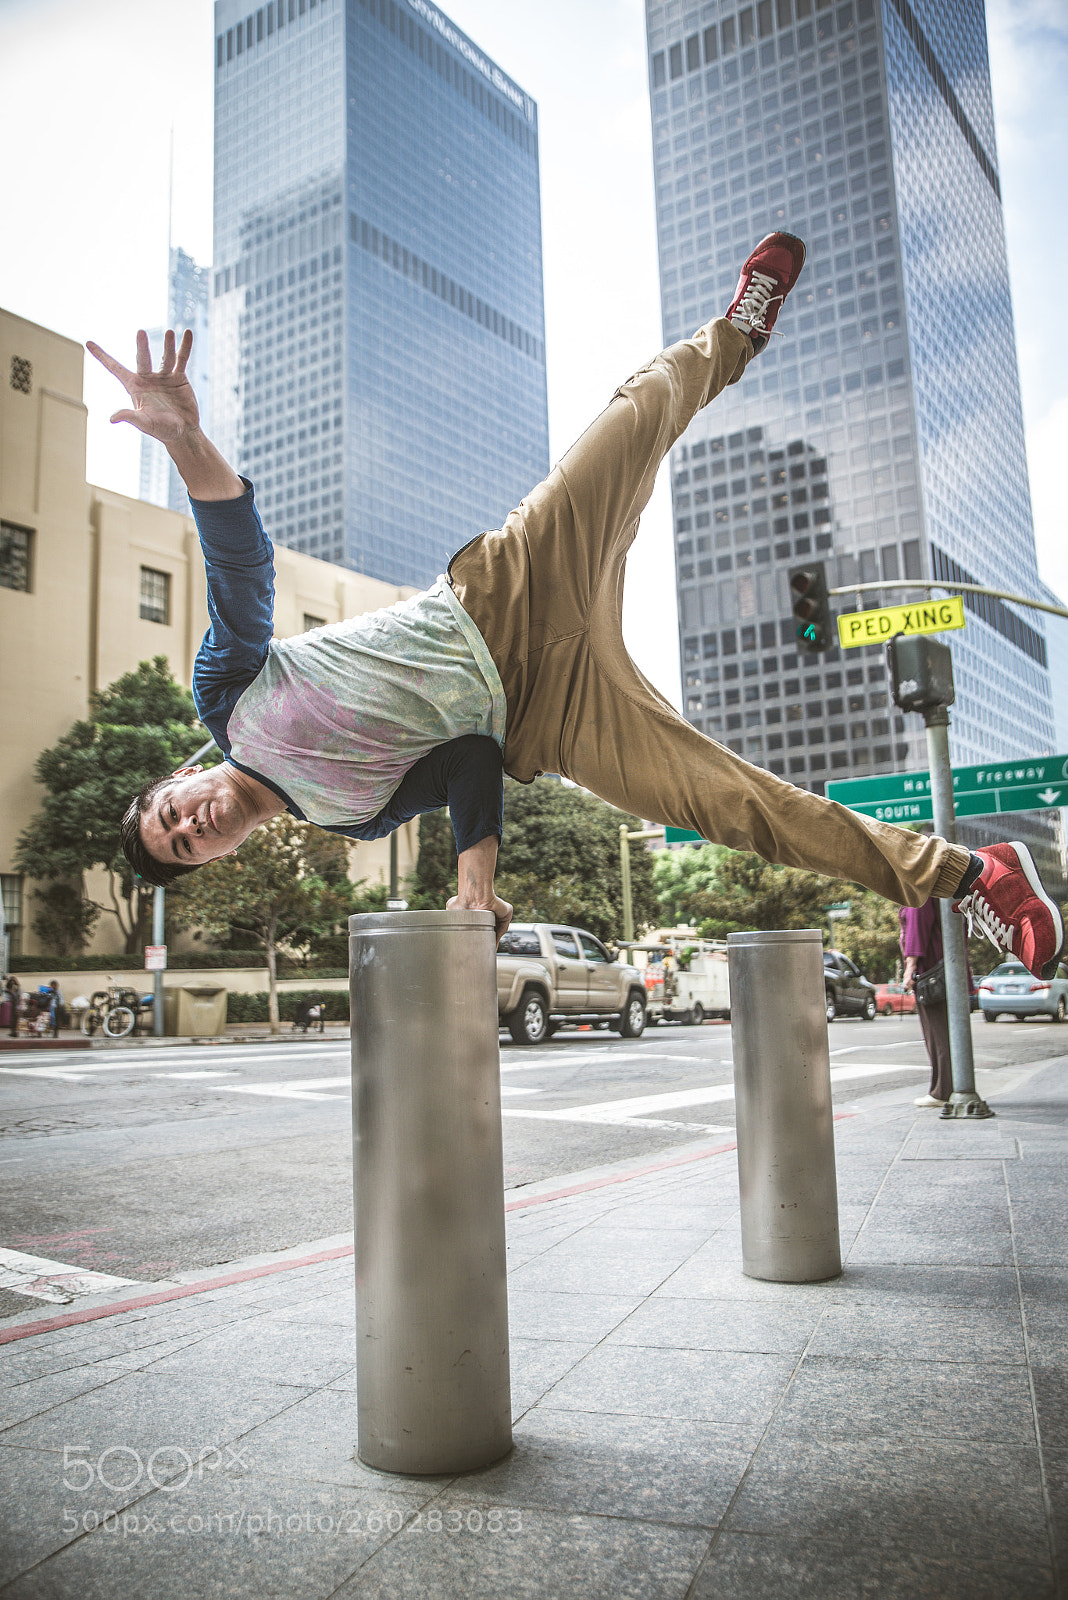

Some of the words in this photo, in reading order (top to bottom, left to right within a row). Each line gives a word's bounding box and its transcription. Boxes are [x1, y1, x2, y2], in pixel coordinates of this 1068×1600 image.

[850, 615, 891, 638] PED
[902, 605, 952, 630] XING
[903, 776, 960, 792] Harr
[976, 766, 1045, 784] Freeway
[875, 803, 920, 820] SOUTH
